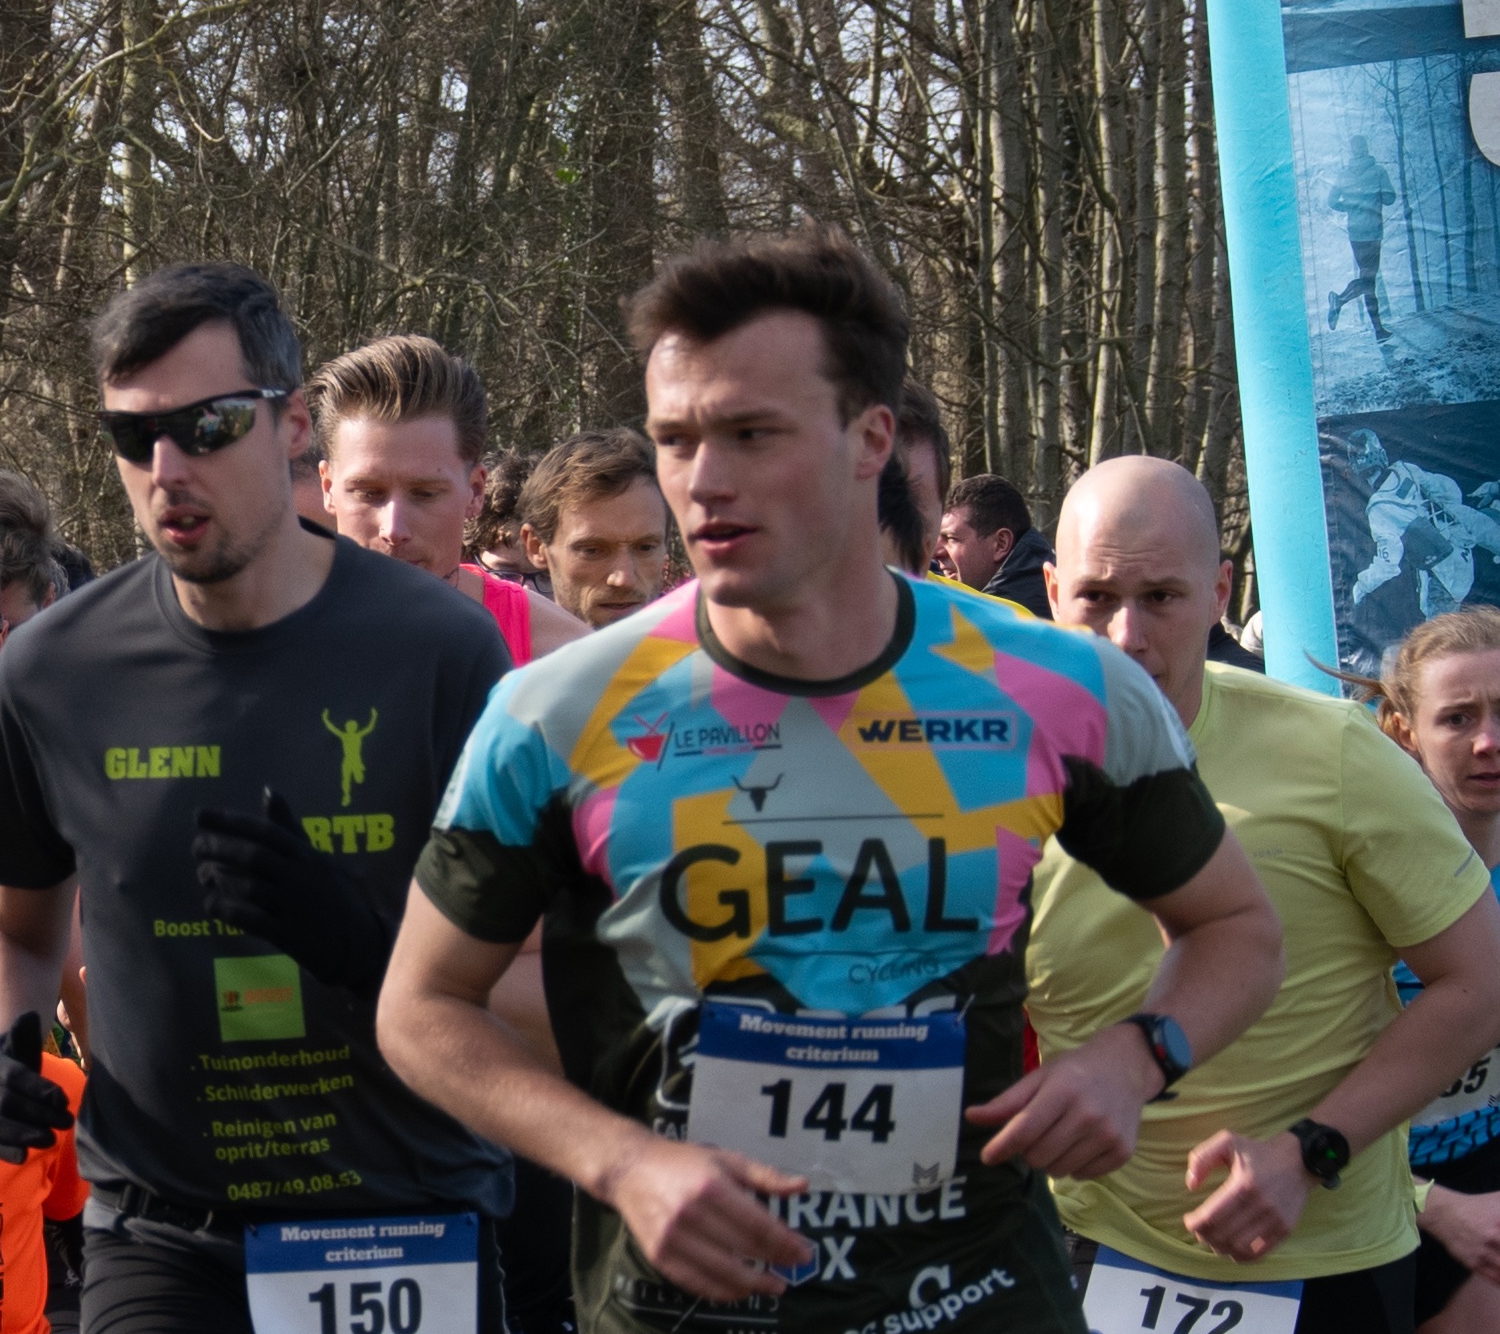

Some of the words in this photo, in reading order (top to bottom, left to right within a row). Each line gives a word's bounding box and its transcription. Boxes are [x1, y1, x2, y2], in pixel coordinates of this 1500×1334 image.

[675, 727, 694, 749] LE
[699, 722, 781, 746] PAVILLON
[858, 719, 1009, 743] WERKR
[105, 745, 221, 780] GLENN
[658, 836, 980, 943] GEAL
[154, 919, 210, 936] Boost
[739, 1014, 848, 1040] Movement
[851, 1022, 929, 1042] running
[786, 1046, 880, 1063] criterium
[761, 1078, 896, 1143] 144
[212, 1119, 297, 1139] Reinigen
[300, 1112, 337, 1132] van
[281, 1224, 375, 1242] Movement
[379, 1221, 446, 1239] running
[325, 1246, 404, 1263] criterium
